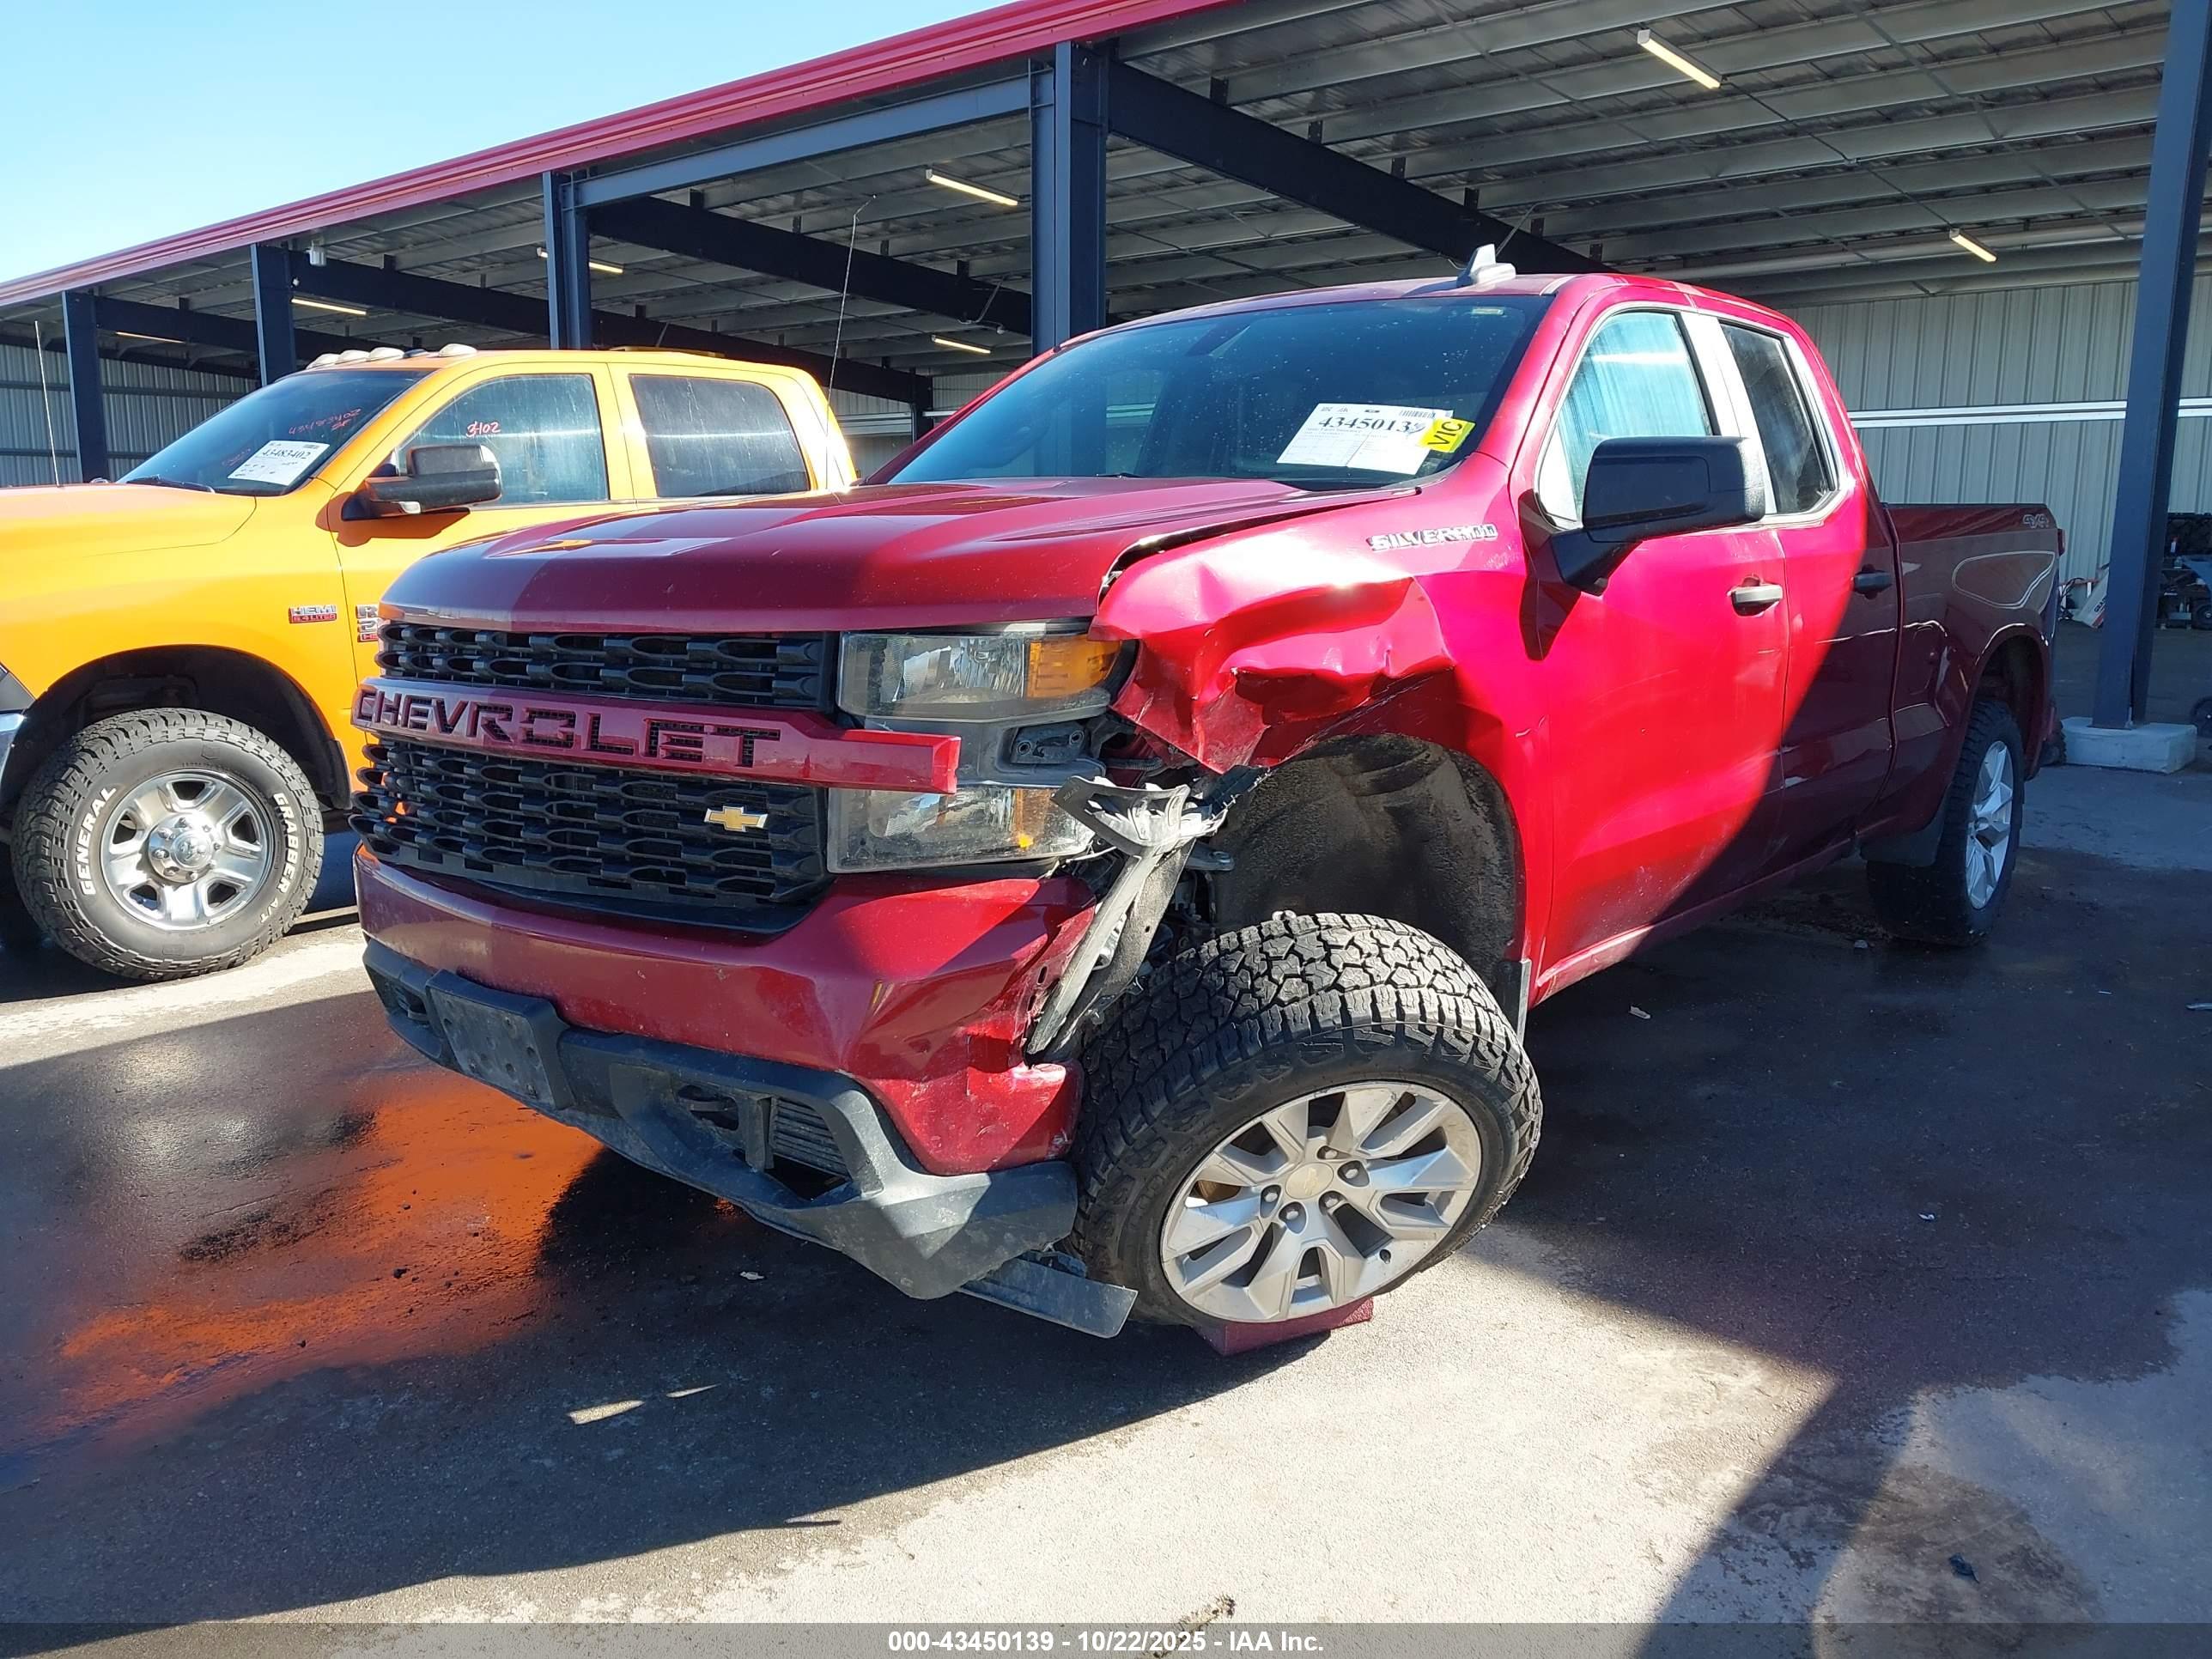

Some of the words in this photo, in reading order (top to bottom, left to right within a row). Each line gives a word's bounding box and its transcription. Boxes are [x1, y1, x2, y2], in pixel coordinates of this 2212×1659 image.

[1427, 421, 1463, 447] VIC
[290, 604, 337, 615] HEMI
[355, 687, 781, 769] CHEVROLET
[75, 786, 117, 895] GENERAL
[273, 792, 299, 894] GRABBER
[260, 897, 278, 923] A/T
